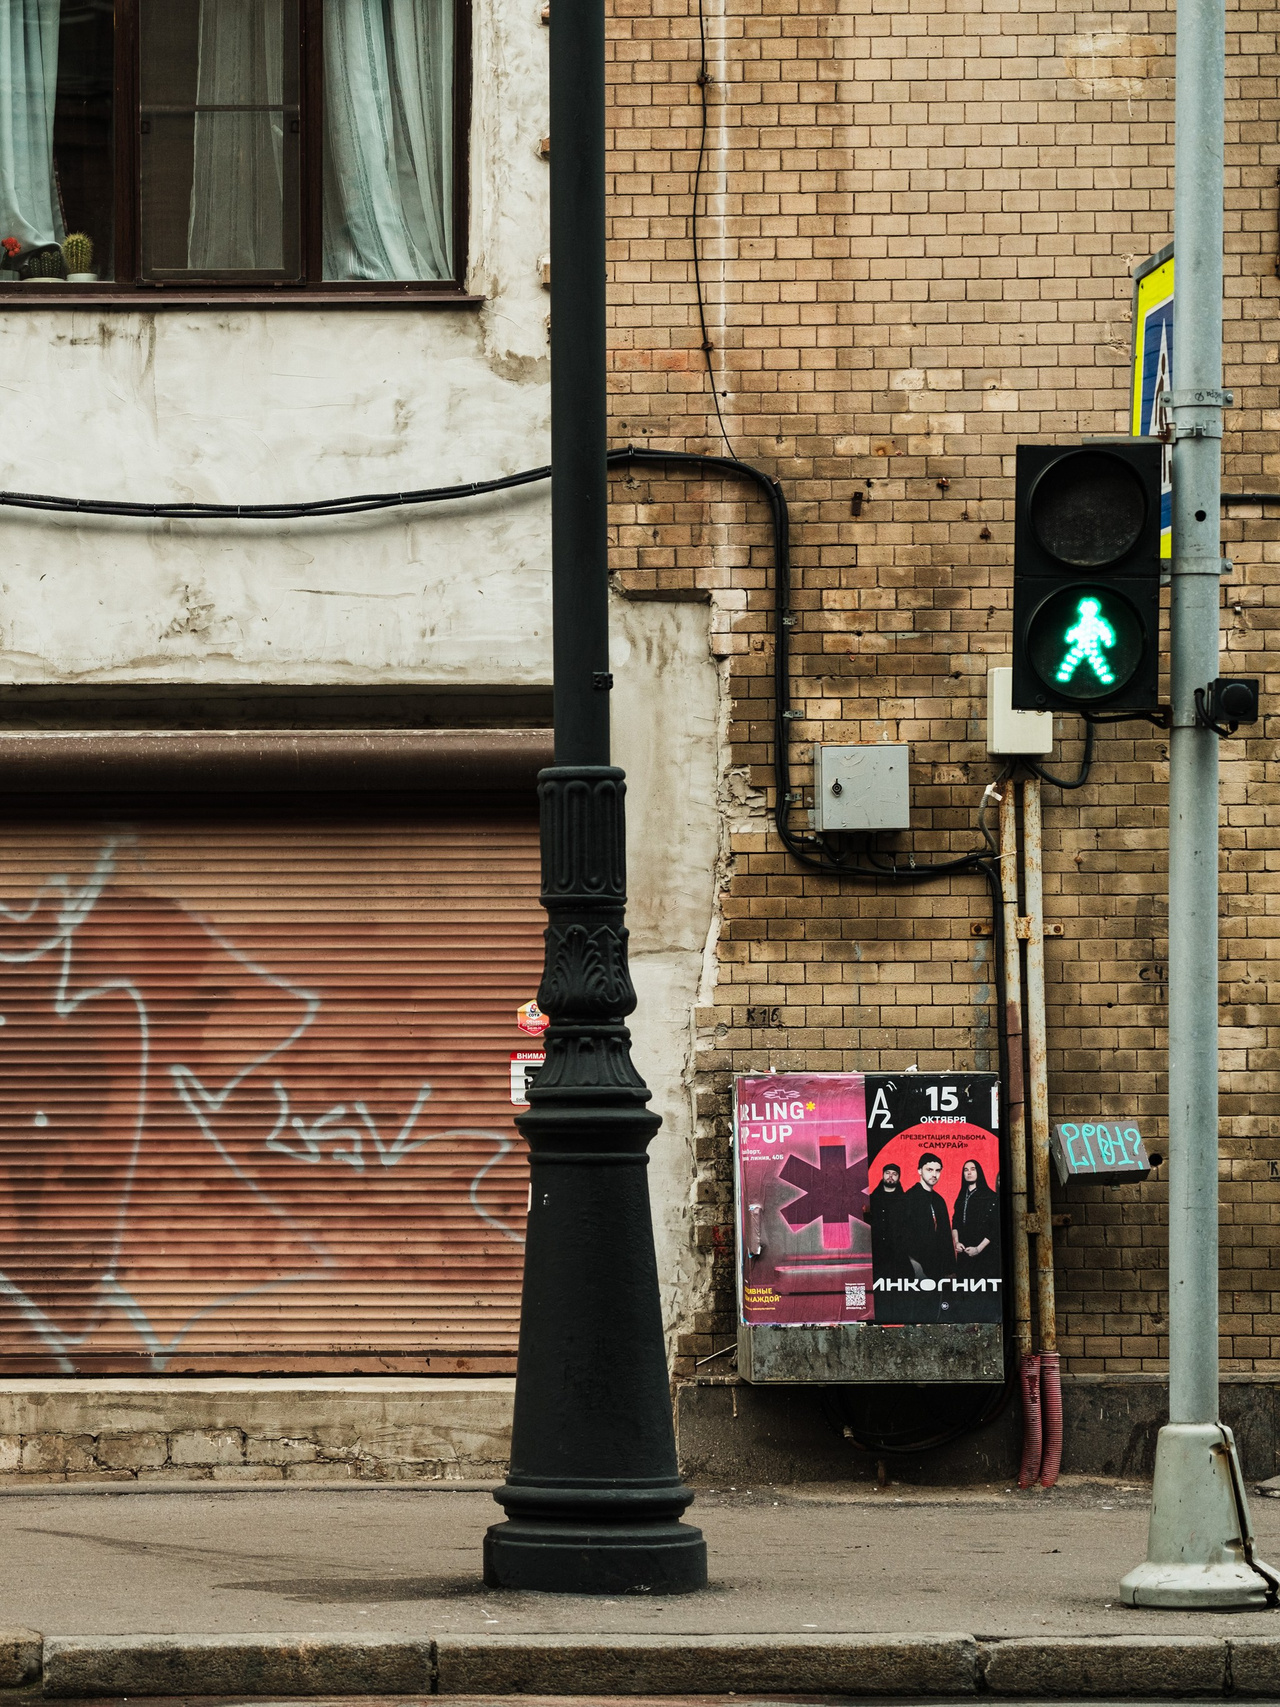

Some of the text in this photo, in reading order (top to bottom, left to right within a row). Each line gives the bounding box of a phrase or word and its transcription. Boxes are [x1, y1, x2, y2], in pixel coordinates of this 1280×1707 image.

[925, 1086, 959, 1112] 15
[920, 1116, 967, 1124] ОКТЯБРЯ
[918, 1141, 969, 1149] «САМУРАЙ»
